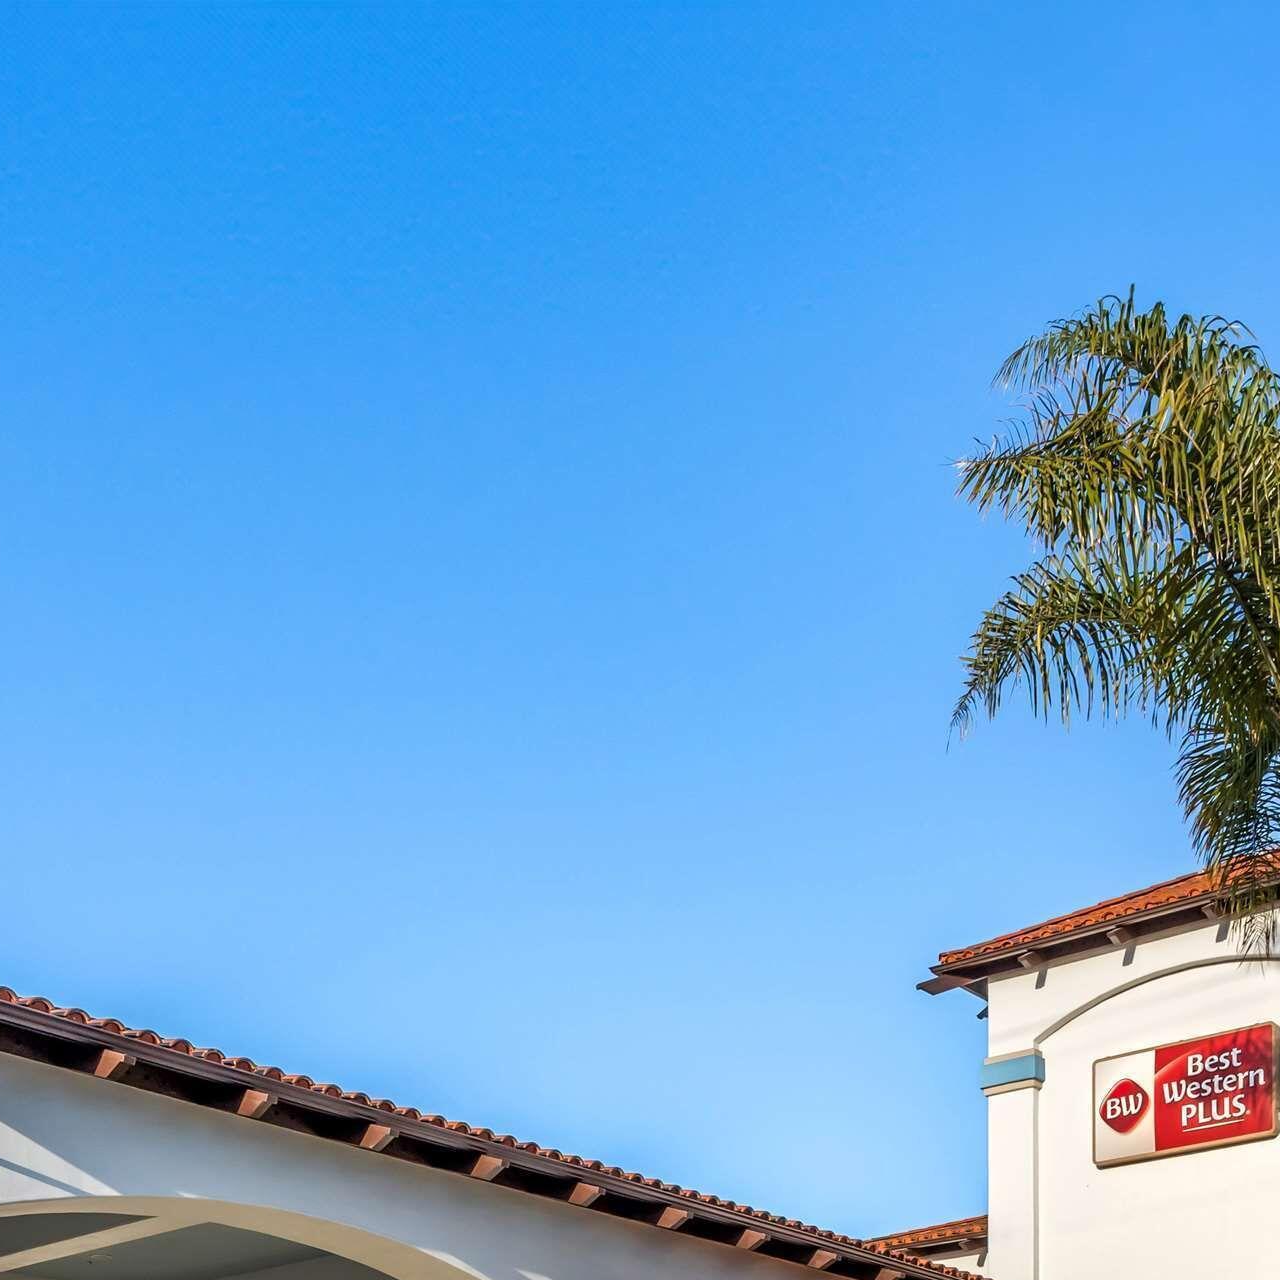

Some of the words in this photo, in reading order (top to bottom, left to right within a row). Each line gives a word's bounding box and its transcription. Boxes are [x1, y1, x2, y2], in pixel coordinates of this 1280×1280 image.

[1187, 1047, 1242, 1076] Best
[1163, 1068, 1266, 1104] Western
[1106, 1092, 1143, 1119] BW
[1180, 1094, 1246, 1127] PLUS
